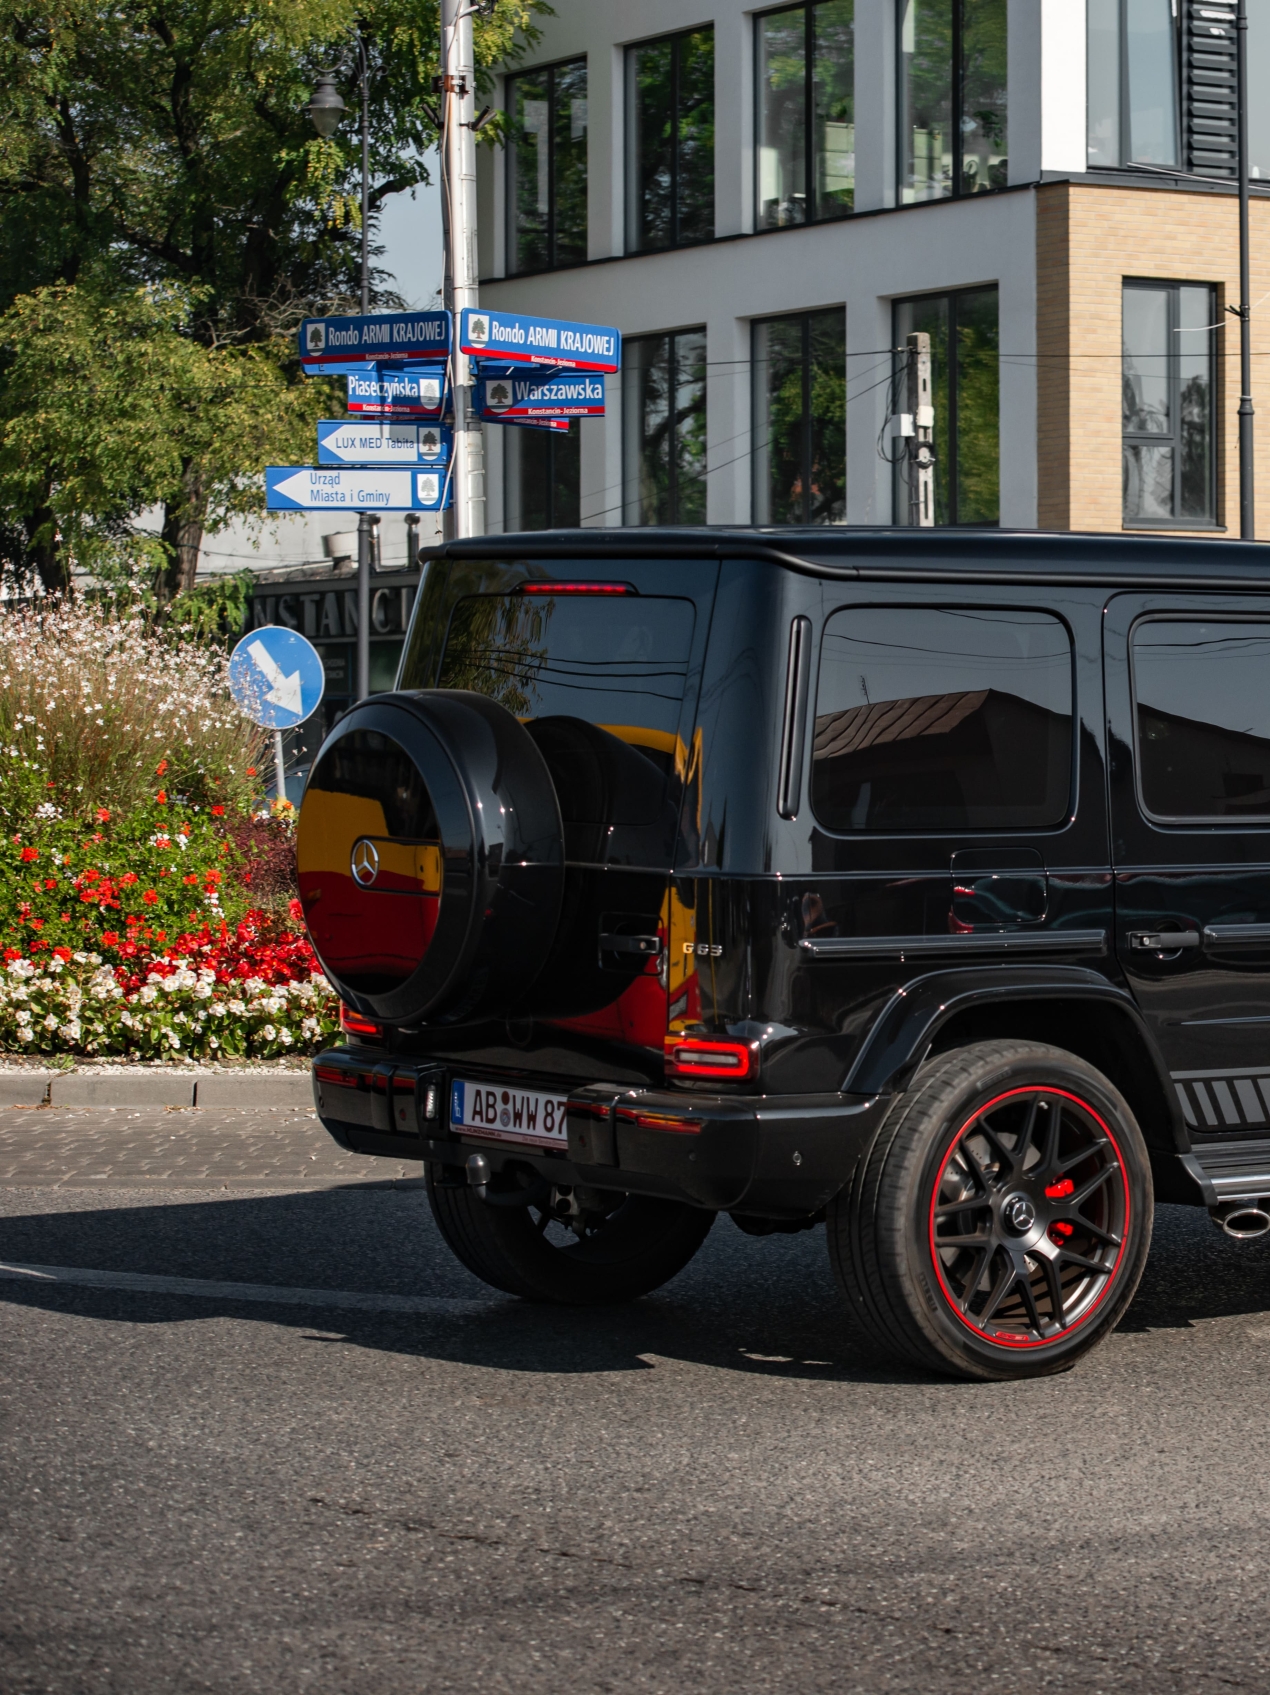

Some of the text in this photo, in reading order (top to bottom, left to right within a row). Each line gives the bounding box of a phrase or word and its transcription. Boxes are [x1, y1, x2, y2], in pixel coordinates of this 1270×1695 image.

[328, 320, 446, 346] Rondo ARMII KRAJOWEJ
[492, 321, 614, 356] Rondo ARMII KRAJOWEJ
[530, 355, 577, 368] Konstancin-Jeziorna
[349, 375, 418, 402] Piaseczyńska
[515, 378, 603, 401] Warszawska
[528, 407, 589, 415] Konstancin-Jeziorna
[335, 437, 415, 449] LUX MED Tabita
[309, 472, 341, 488] Urząd
[310, 489, 391, 505] Miasta i Gminy
[471, 1088, 498, 1125] AB
[512, 1094, 539, 1130] WW
